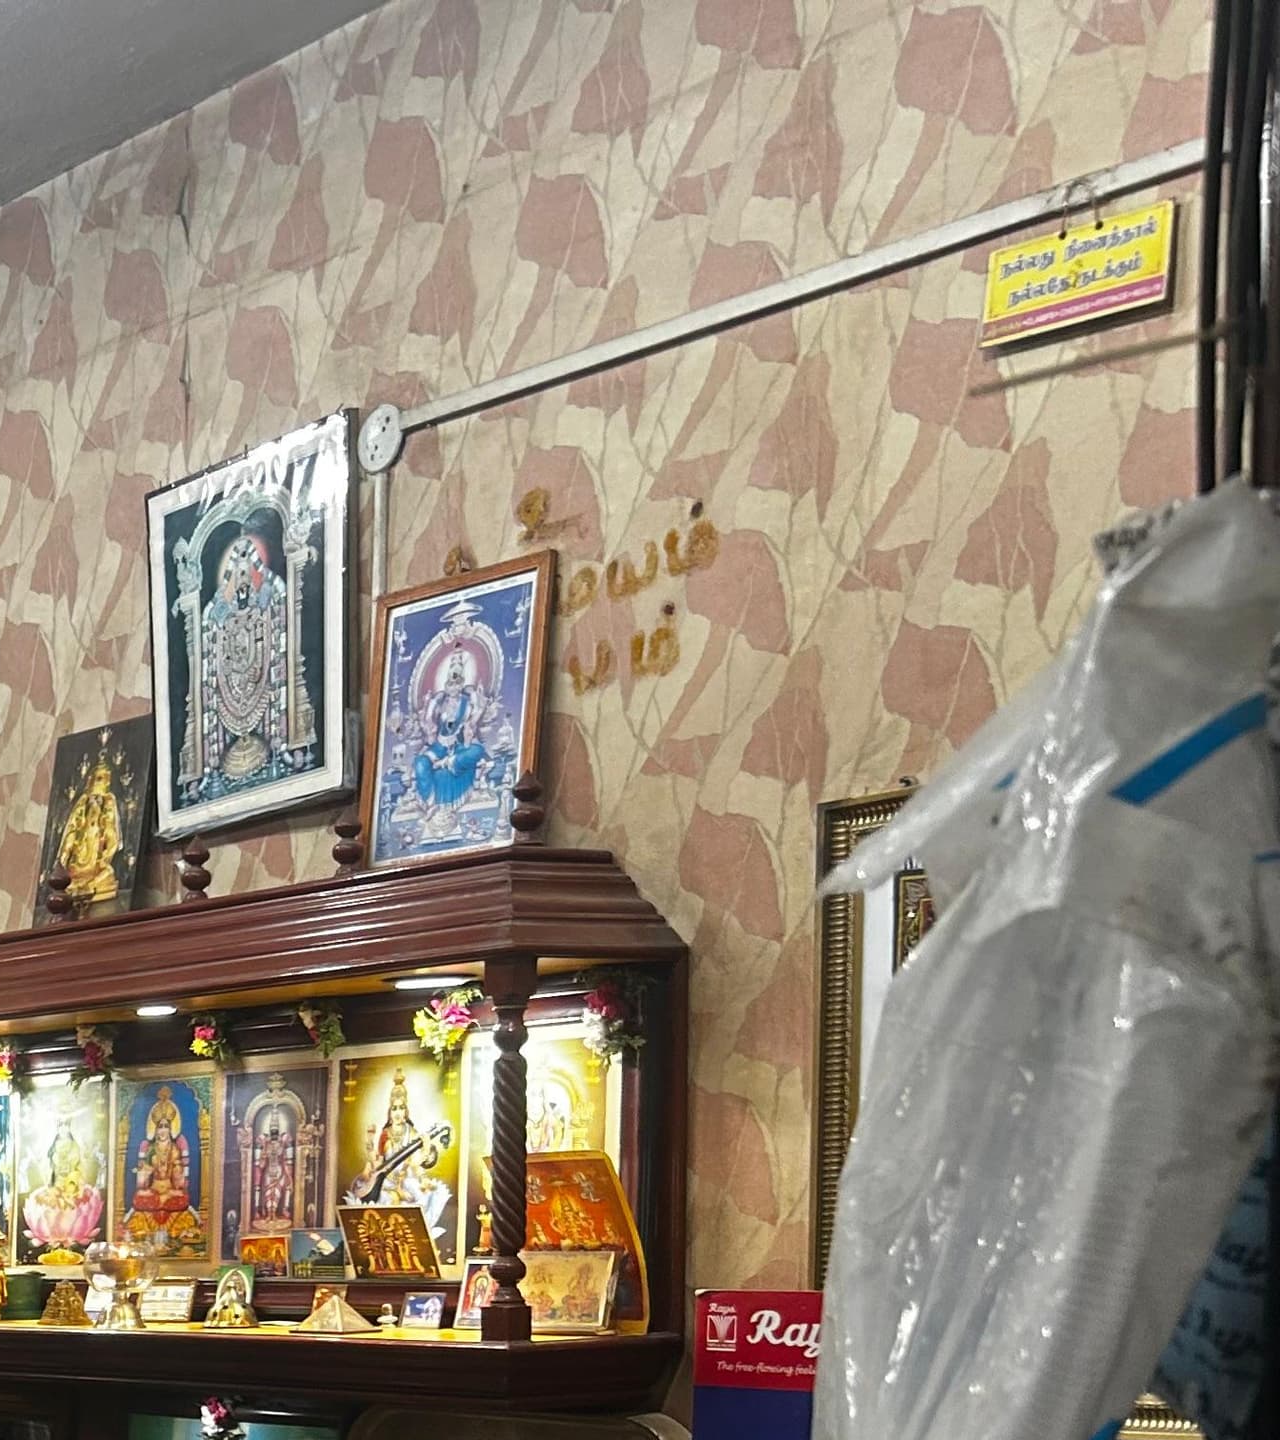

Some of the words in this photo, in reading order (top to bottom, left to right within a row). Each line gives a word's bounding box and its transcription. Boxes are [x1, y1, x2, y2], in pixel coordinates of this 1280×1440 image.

[708, 1303, 736, 1314] Rays
[746, 1310, 821, 1358] Ray
[717, 1361, 734, 1371] The
